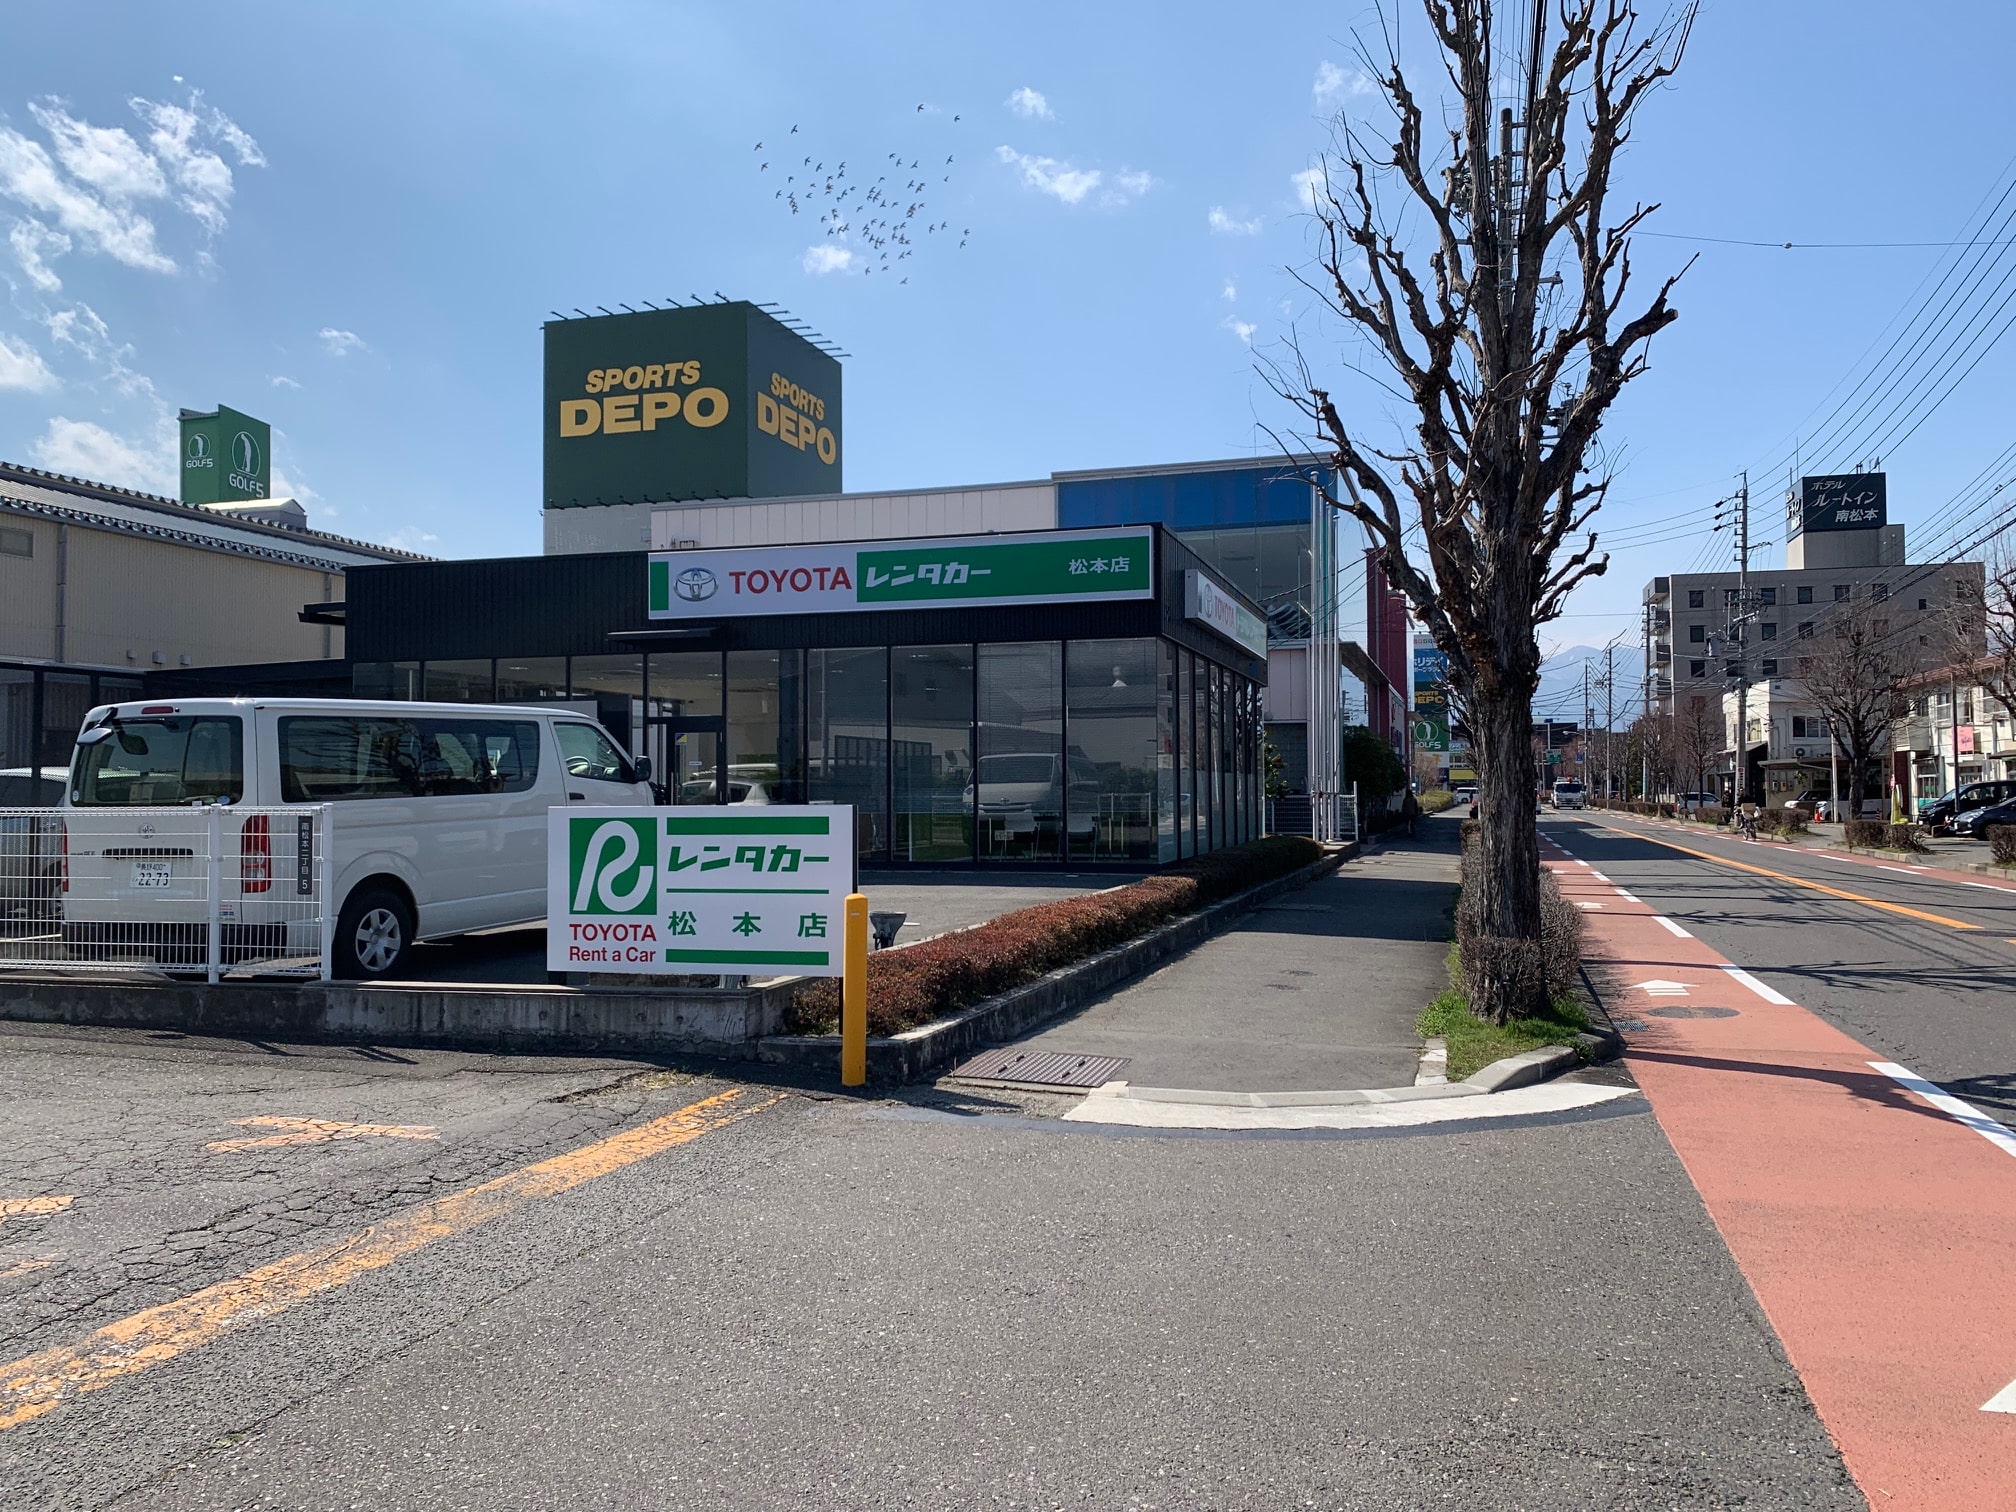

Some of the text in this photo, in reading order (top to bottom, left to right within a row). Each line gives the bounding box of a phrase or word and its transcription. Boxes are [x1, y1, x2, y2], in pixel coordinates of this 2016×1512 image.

[585, 360, 701, 394] SPORTS
[770, 372, 825, 422] SPORTS
[559, 387, 730, 438] DEPO
[757, 391, 837, 465] DEPO
[186, 458, 213, 468] GOLF5
[229, 473, 264, 499] GOLF5
[1811, 480, 1847, 491] ホテル
[1812, 491, 1878, 507] ルートイン
[1835, 508, 1879, 522] 南松本
[728, 556, 1131, 595] TOYOTA レンタカー 松本店
[1215, 595, 1234, 627] TOYOTA
[667, 844, 830, 872] レンタカー
[138, 872, 169, 886] 22-73
[302, 879, 308, 890] 5
[569, 923, 657, 942] TOYOTA
[569, 946, 657, 963] Rent a Car
